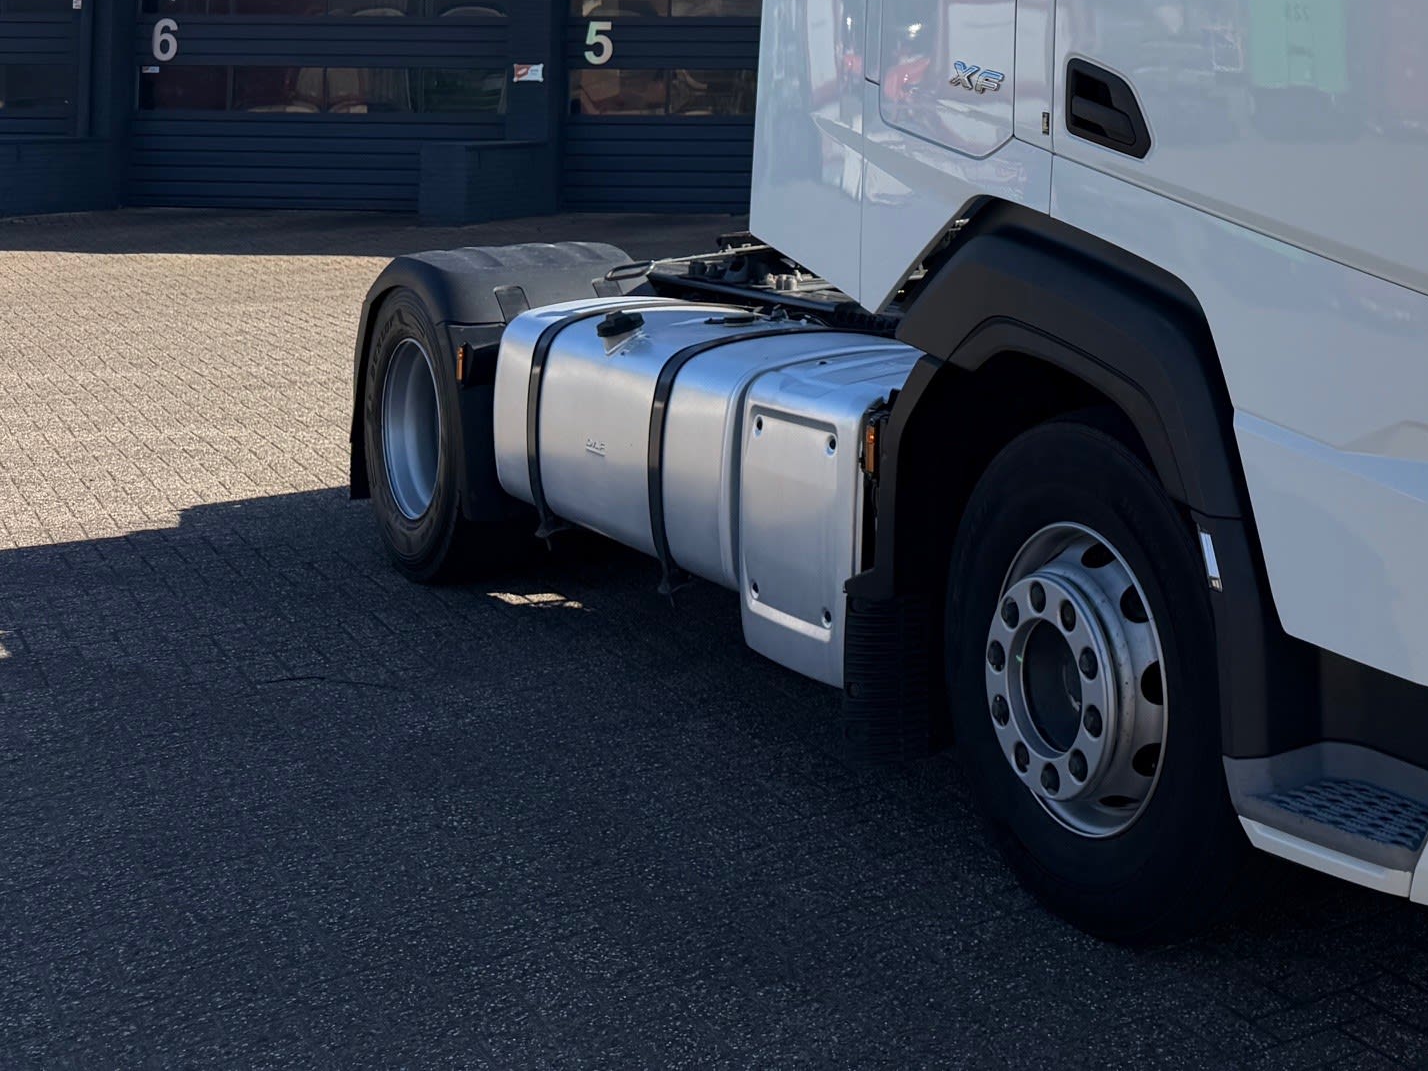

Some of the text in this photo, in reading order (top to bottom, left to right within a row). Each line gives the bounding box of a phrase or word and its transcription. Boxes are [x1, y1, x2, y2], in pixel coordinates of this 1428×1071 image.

[152, 18, 178, 61] 6
[584, 21, 613, 65] 5
[949, 60, 1005, 94] XF
